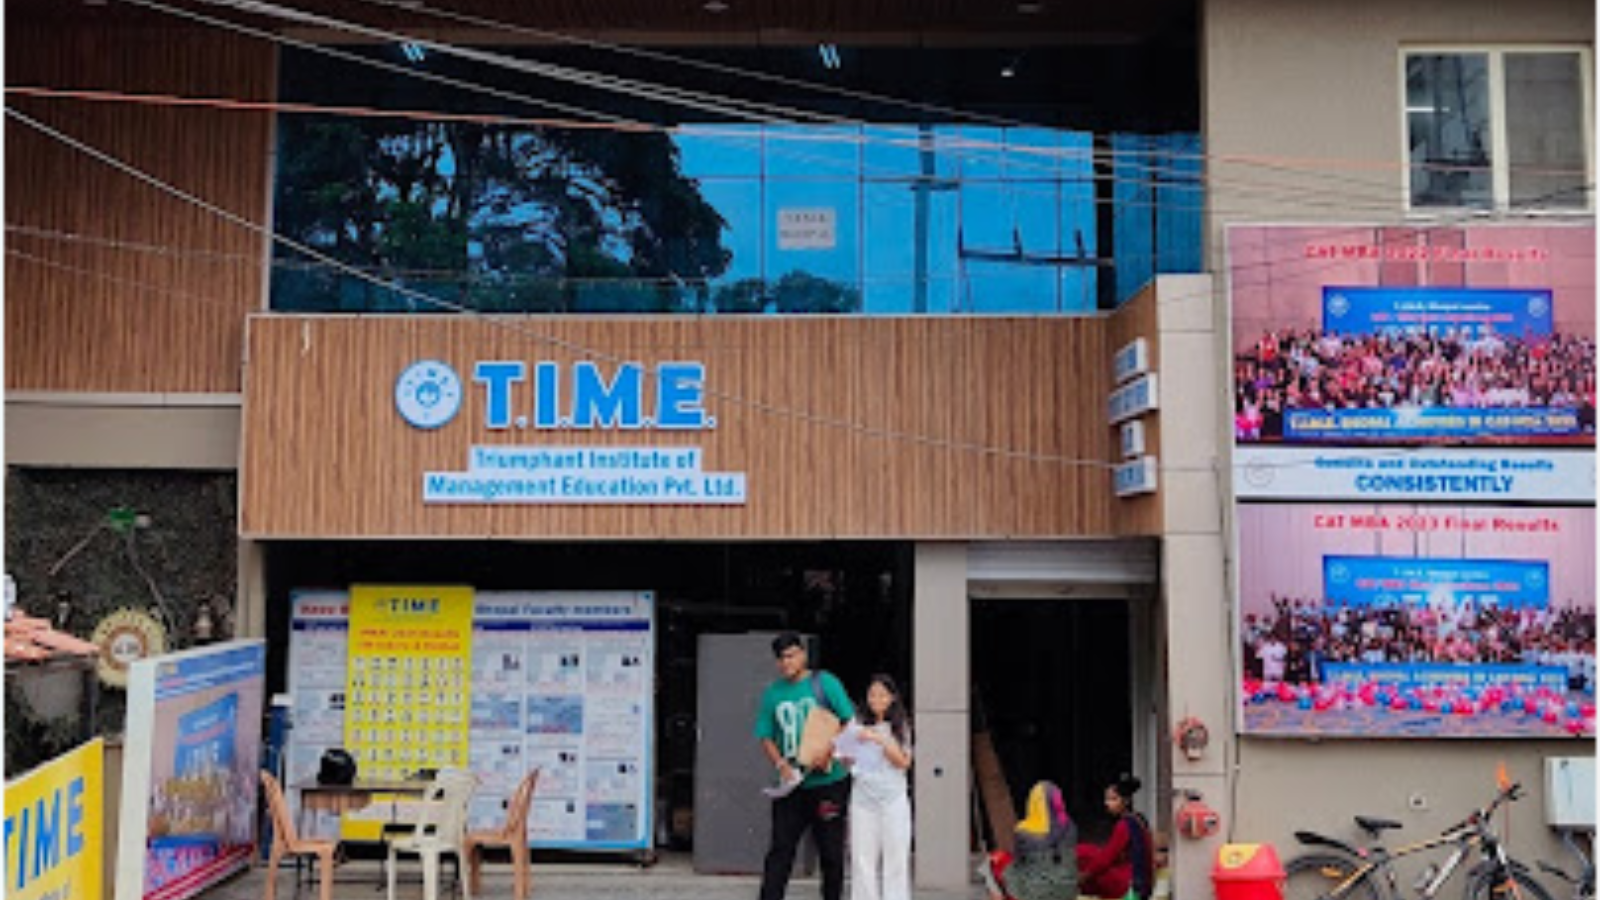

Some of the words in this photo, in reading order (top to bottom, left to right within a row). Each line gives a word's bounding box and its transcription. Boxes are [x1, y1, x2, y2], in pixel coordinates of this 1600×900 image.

[474, 361, 718, 429] T.I.M.E.
[475, 450, 584, 472] Triumphant
[590, 450, 670, 469] Institute
[675, 450, 696, 469] of
[427, 476, 556, 500] Management
[561, 476, 659, 496] Education
[663, 476, 698, 496] Pvt.
[703, 476, 742, 496] Ltd.
[1355, 474, 1514, 493] CONSISTENTLY
